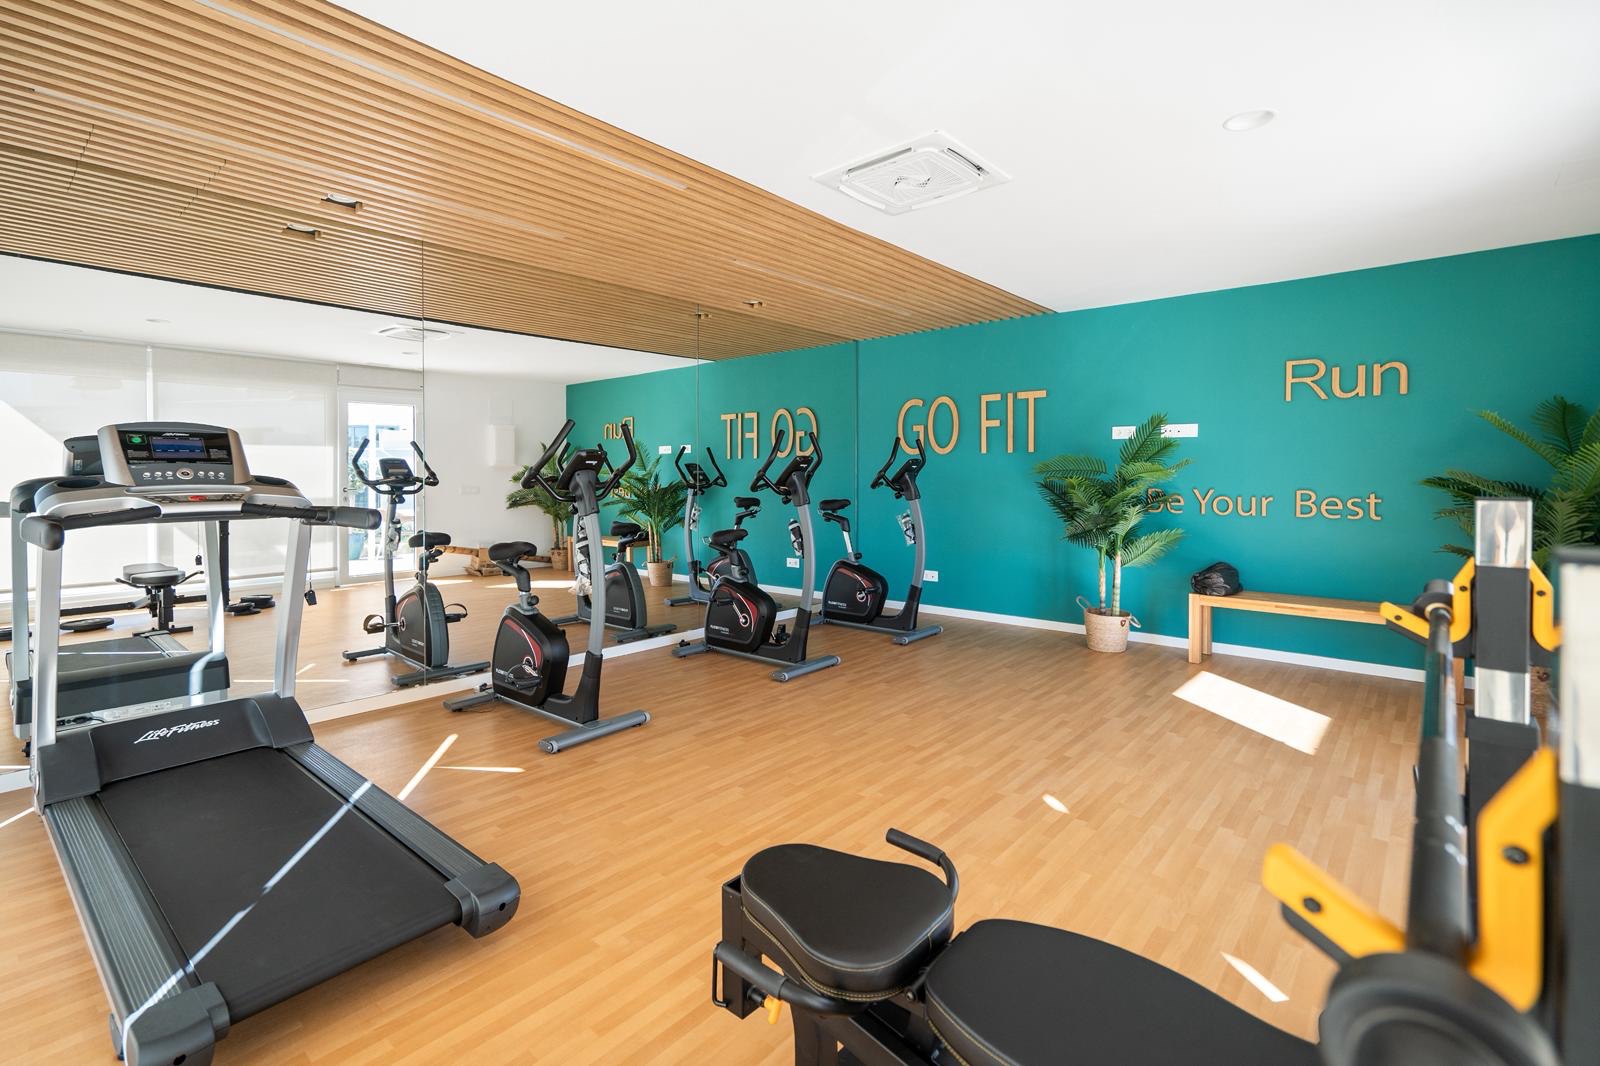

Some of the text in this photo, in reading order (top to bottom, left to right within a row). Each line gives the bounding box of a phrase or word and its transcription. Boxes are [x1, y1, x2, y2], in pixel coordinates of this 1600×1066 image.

[1285, 358, 1410, 403] Run
[897, 389, 1048, 456] GO FIT
[1192, 488, 1273, 518] Your
[1295, 489, 1382, 521] Best
